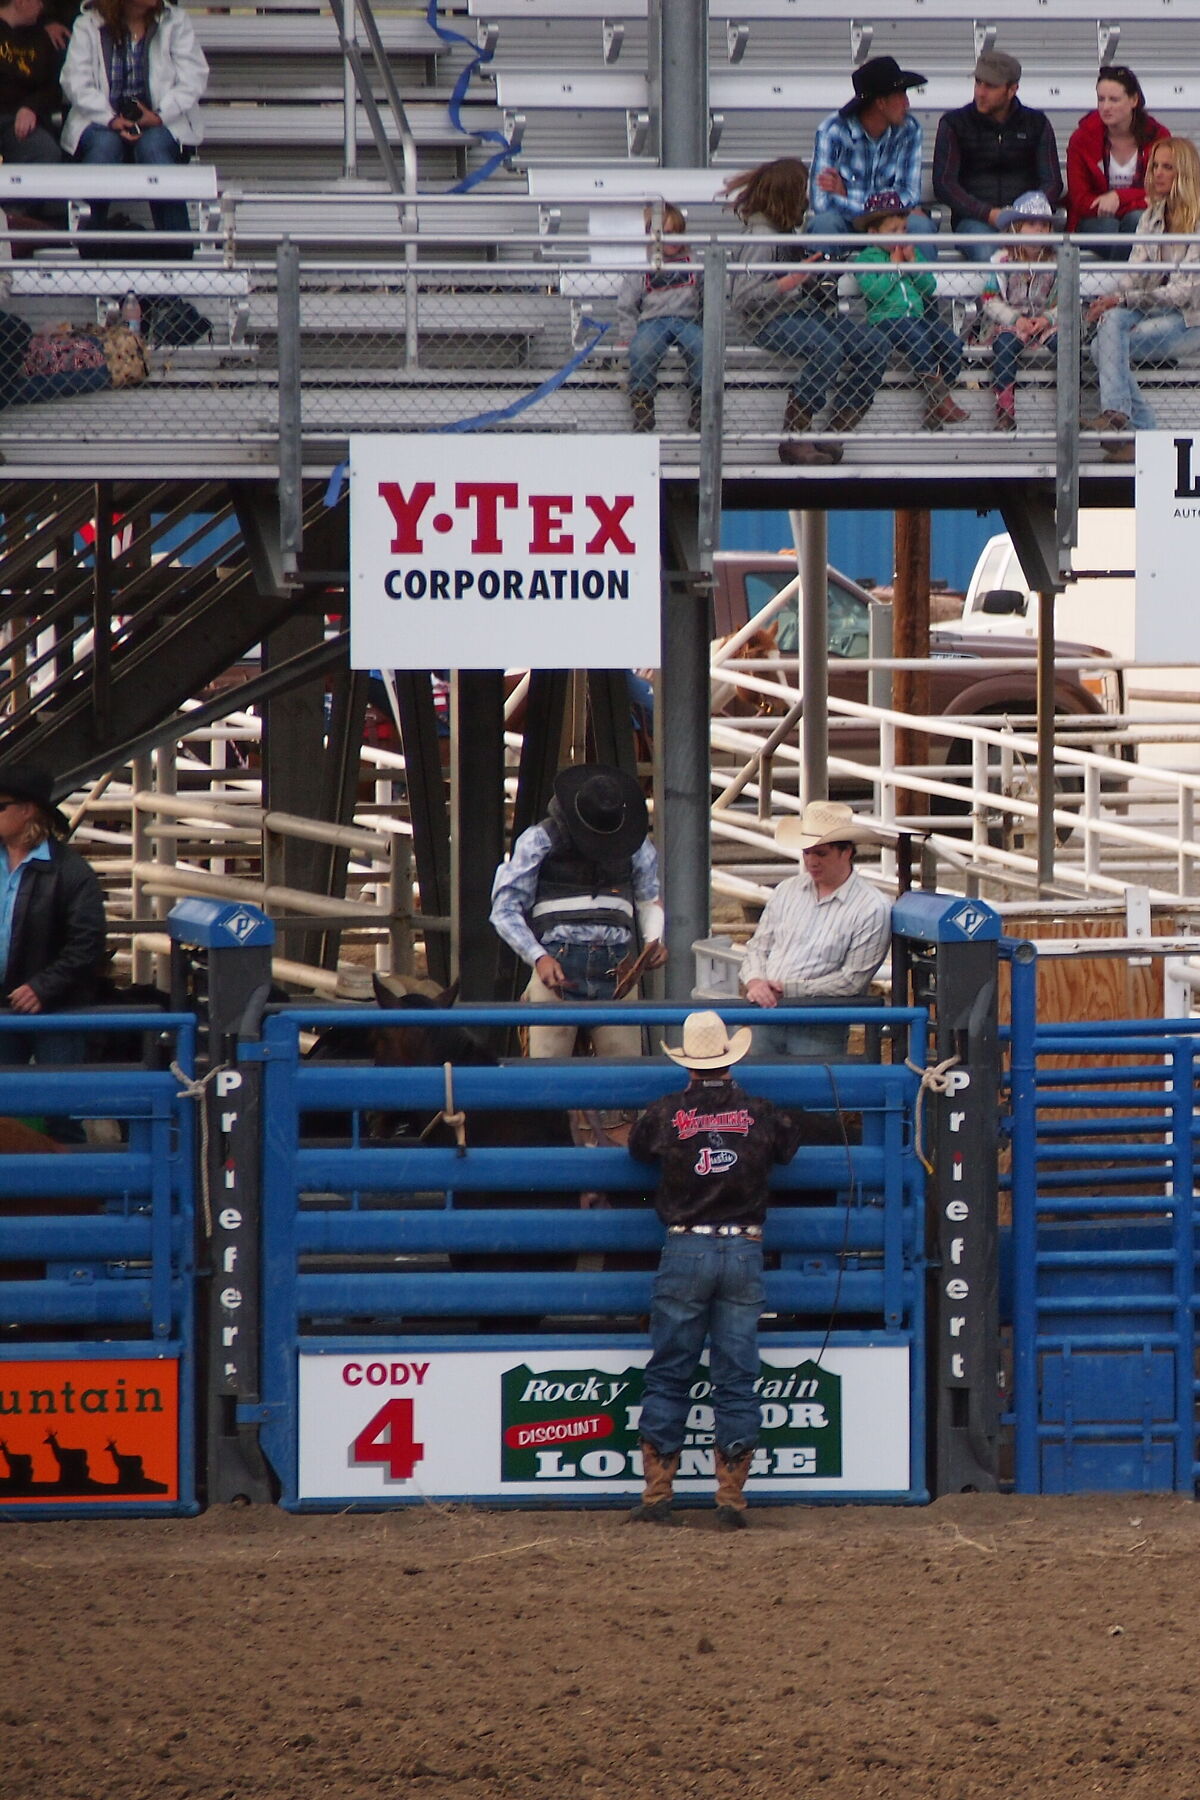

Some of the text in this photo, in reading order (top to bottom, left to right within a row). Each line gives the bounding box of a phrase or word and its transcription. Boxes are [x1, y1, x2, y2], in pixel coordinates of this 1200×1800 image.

[384, 569, 629, 599] CORPORATION
[342, 1362, 431, 1386] CODY
[519, 1376, 630, 1407] Rocky
[347, 1398, 424, 1485] 4
[517, 1417, 602, 1446] DISCOUNT
